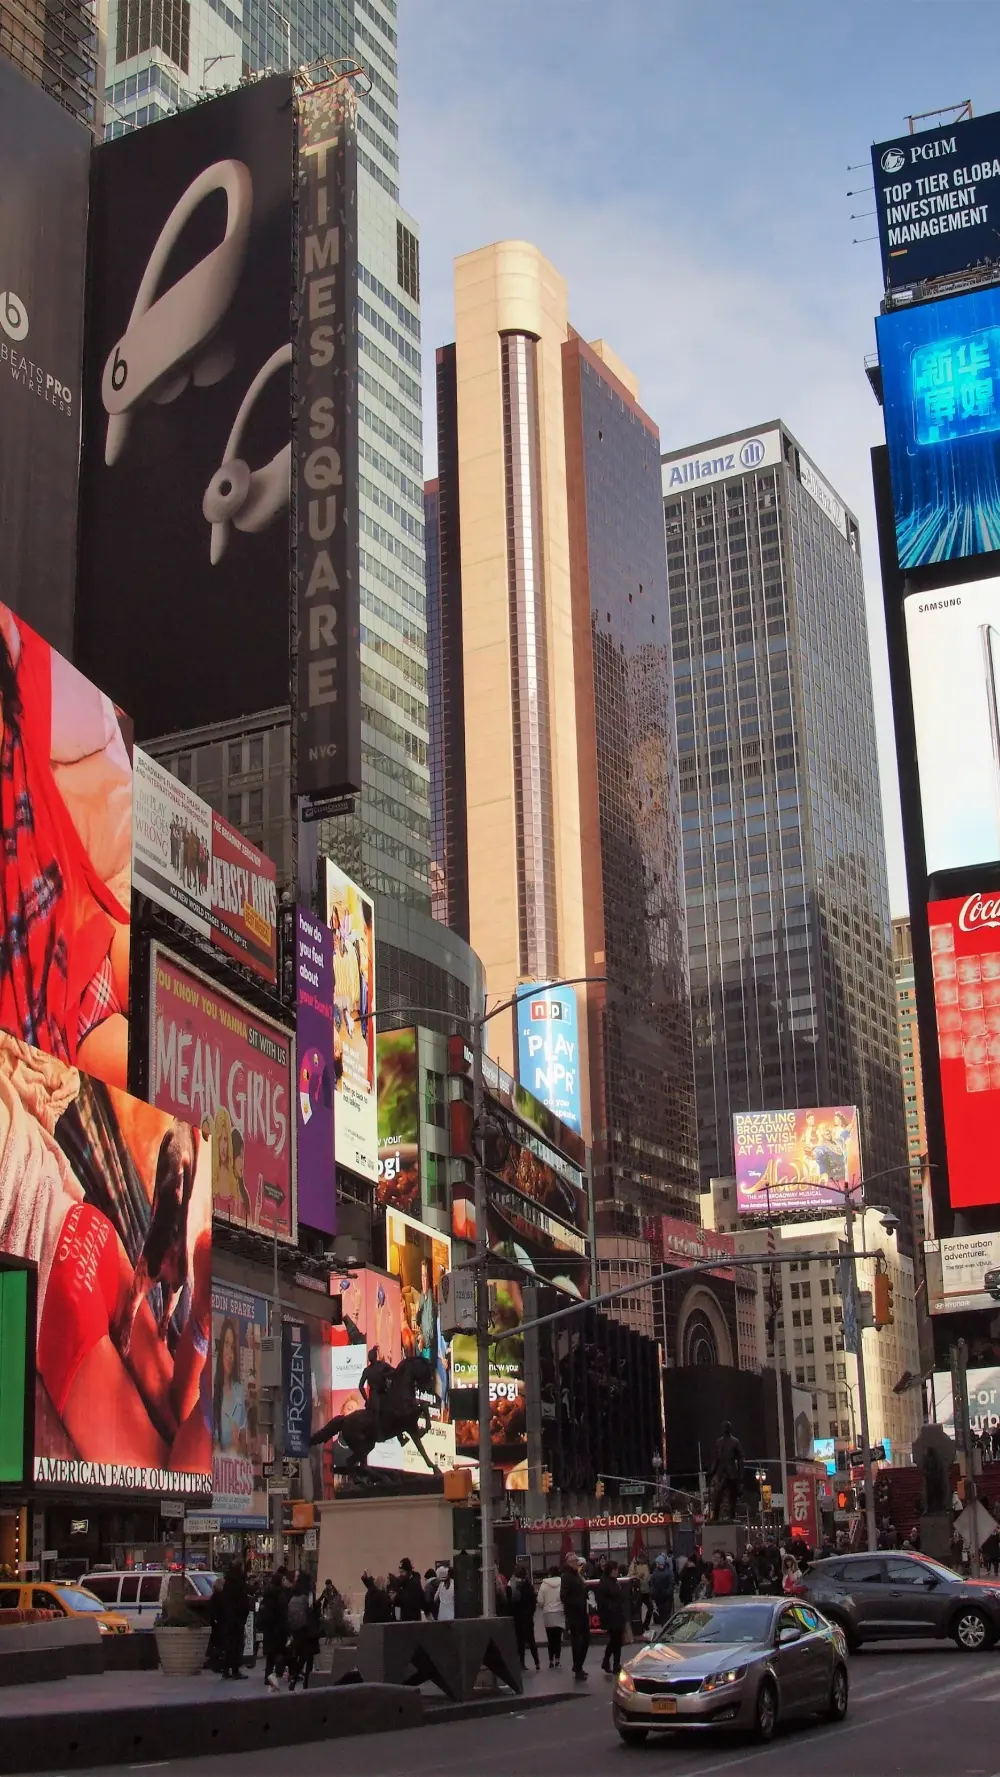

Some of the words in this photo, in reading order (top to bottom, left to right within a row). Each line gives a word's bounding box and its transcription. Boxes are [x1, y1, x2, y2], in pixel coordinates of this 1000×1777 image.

[910, 137, 957, 163] PGIM
[883, 182, 912, 204] TOP
[916, 173, 949, 195] TIER
[886, 187, 976, 225] INVESTMENT
[888, 205, 988, 246] MANAGEMENT
[304, 136, 339, 367] TIMES
[11, 367, 72, 417] WIRELESS
[669, 453, 735, 487] Allianz
[303, 396, 342, 707] SQUARE
[918, 597, 962, 613] SAMSUNG
[308, 743, 337, 761] NYC
[135, 765, 146, 779] AND
[147, 774, 181, 807] INTERNATIONAL
[150, 794, 167, 819] PLAY
[135, 815, 169, 857] WRONG
[210, 855, 249, 917] JERSEY
[251, 872, 277, 928] BOYS
[178, 891, 188, 905] NEW
[188, 898, 205, 916] WORLD
[205, 909, 220, 928] STAGES
[299, 913, 314, 937] how
[313, 926, 322, 943] do
[299, 941, 312, 959] you
[312, 946, 324, 968] feel
[299, 963, 319, 988] about
[299, 988, 314, 1007] your
[156, 967, 171, 991] YOU
[173, 979, 199, 1008] KNOW
[201, 995, 218, 1020] YOU
[219, 1007, 248, 1040] WANNA
[248, 1028, 259, 1047] SIT
[259, 1034, 277, 1059] WITH
[533, 1003, 570, 1022] npr
[155, 1015, 222, 1117] MEAN
[226, 1059, 287, 1157] GIRLS
[735, 1112, 796, 1126] DAZZLING
[736, 1122, 795, 1135] BROADWAY
[383, 1135, 402, 1148] your
[737, 1134, 762, 1145] ONE
[766, 1131, 796, 1144] WISH
[738, 1145, 753, 1156] AT
[755, 1144, 765, 1155] A
[767, 1142, 796, 1154] TIME
[747, 1170, 761, 1178] Disney
[944, 1244, 955, 1252] For
[957, 1242, 969, 1251] the
[970, 1240, 993, 1249] urban
[944, 1250, 987, 1261] adventurer.
[944, 1300, 971, 1309] HYUNDAI
[454, 1363, 466, 1373] Do
[468, 1364, 477, 1376] yo
[506, 1364, 519, 1376] your
[288, 1343, 307, 1434] FROZEN
[37, 1457, 108, 1485] AMERICAN
[111, 1464, 147, 1489] EAGLE
[149, 1468, 213, 1495] OUTFITTERS
[793, 1480, 810, 1521] tkts
[588, 1518, 606, 1528] NYC
[608, 1512, 665, 1527] HOTDOGS
